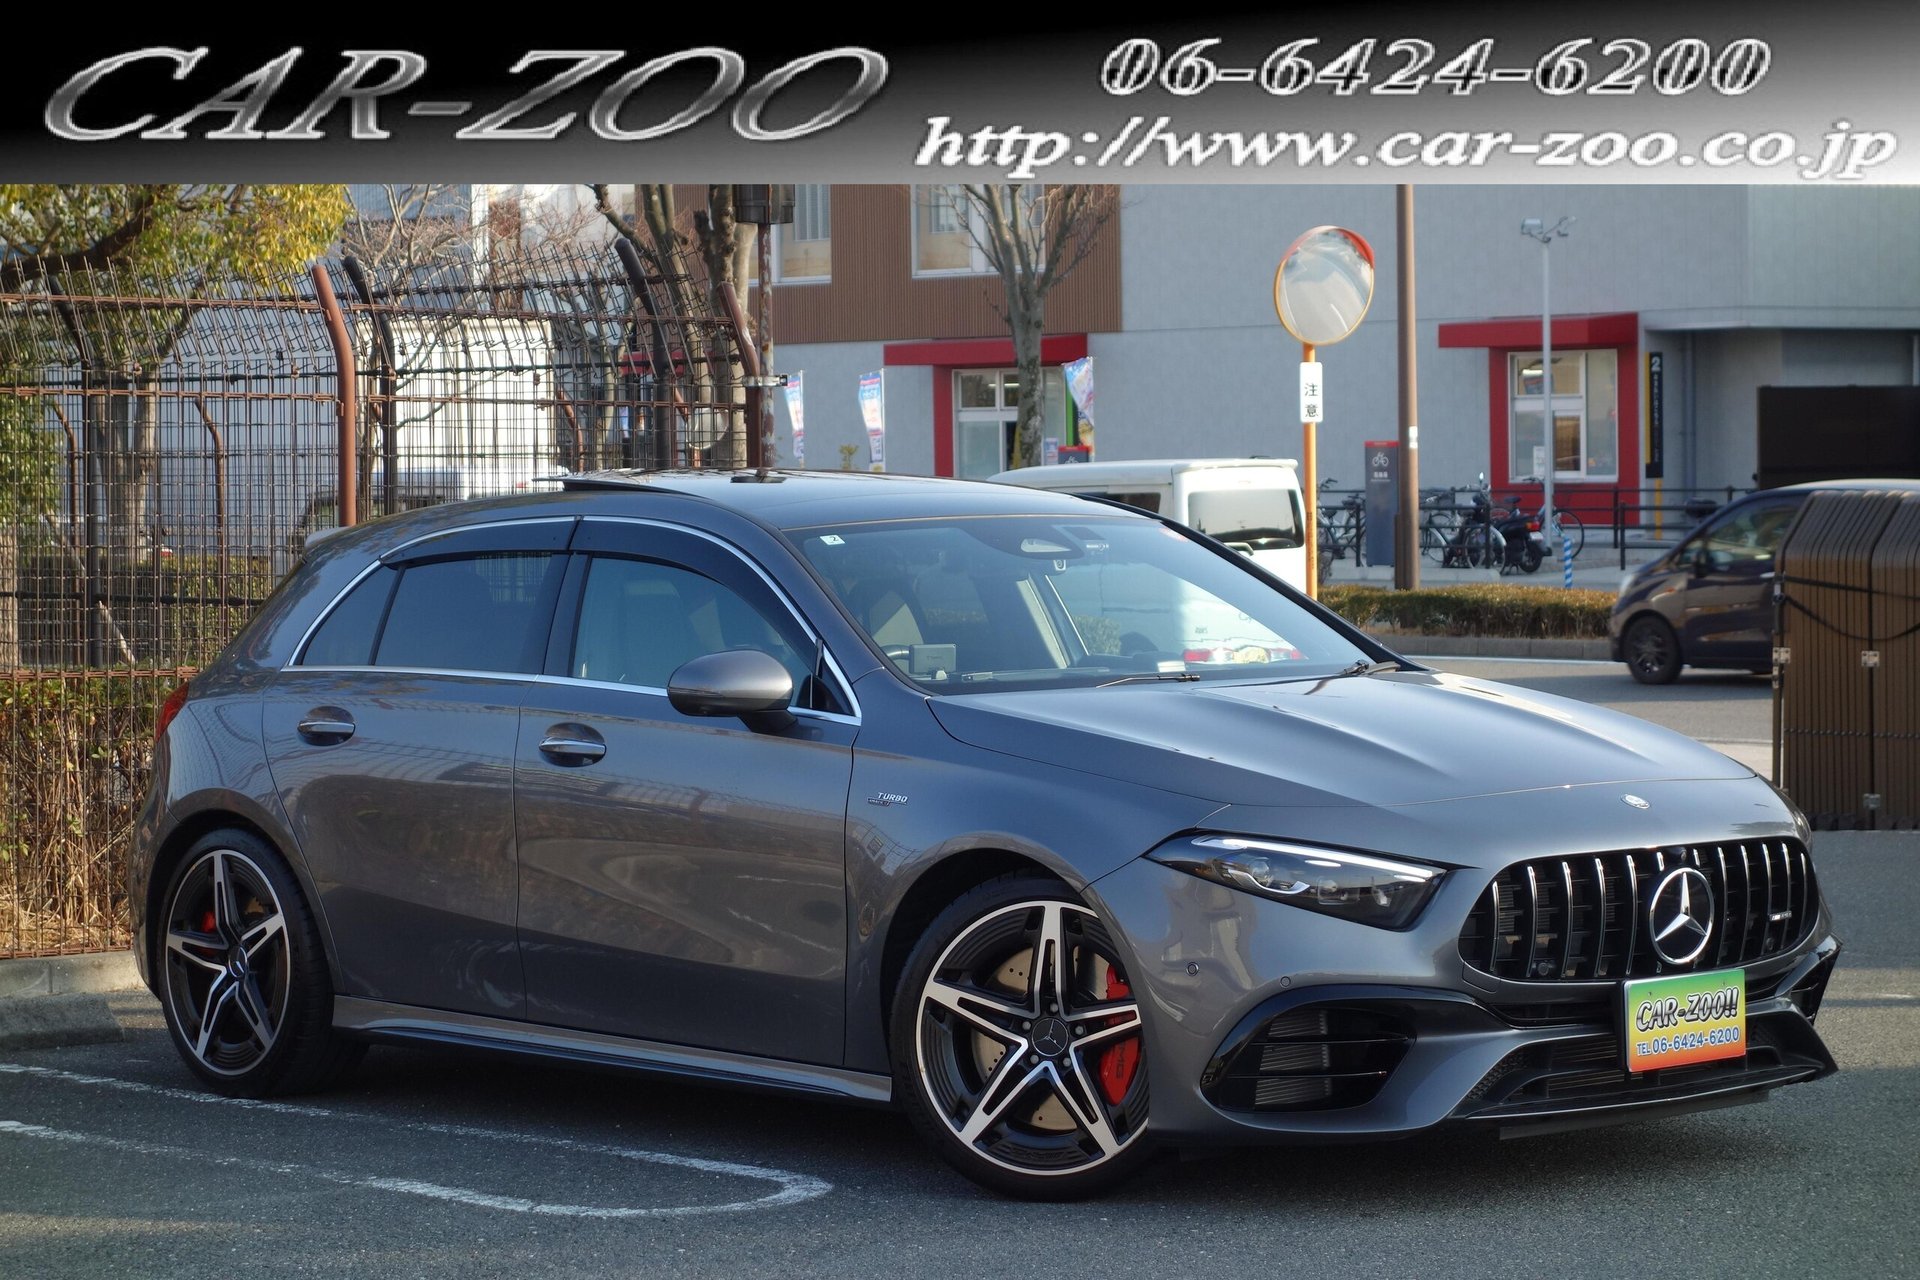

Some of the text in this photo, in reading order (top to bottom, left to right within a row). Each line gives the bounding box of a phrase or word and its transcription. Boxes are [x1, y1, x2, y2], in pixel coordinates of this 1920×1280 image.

[1652, 356, 1661, 372] 2
[1304, 382, 1319, 418] 注意
[877, 791, 908, 803] TURBO
[1636, 987, 1740, 1031] CAR-ZOO!!
[1637, 1026, 1741, 1056] TEL 06-6424-6200
